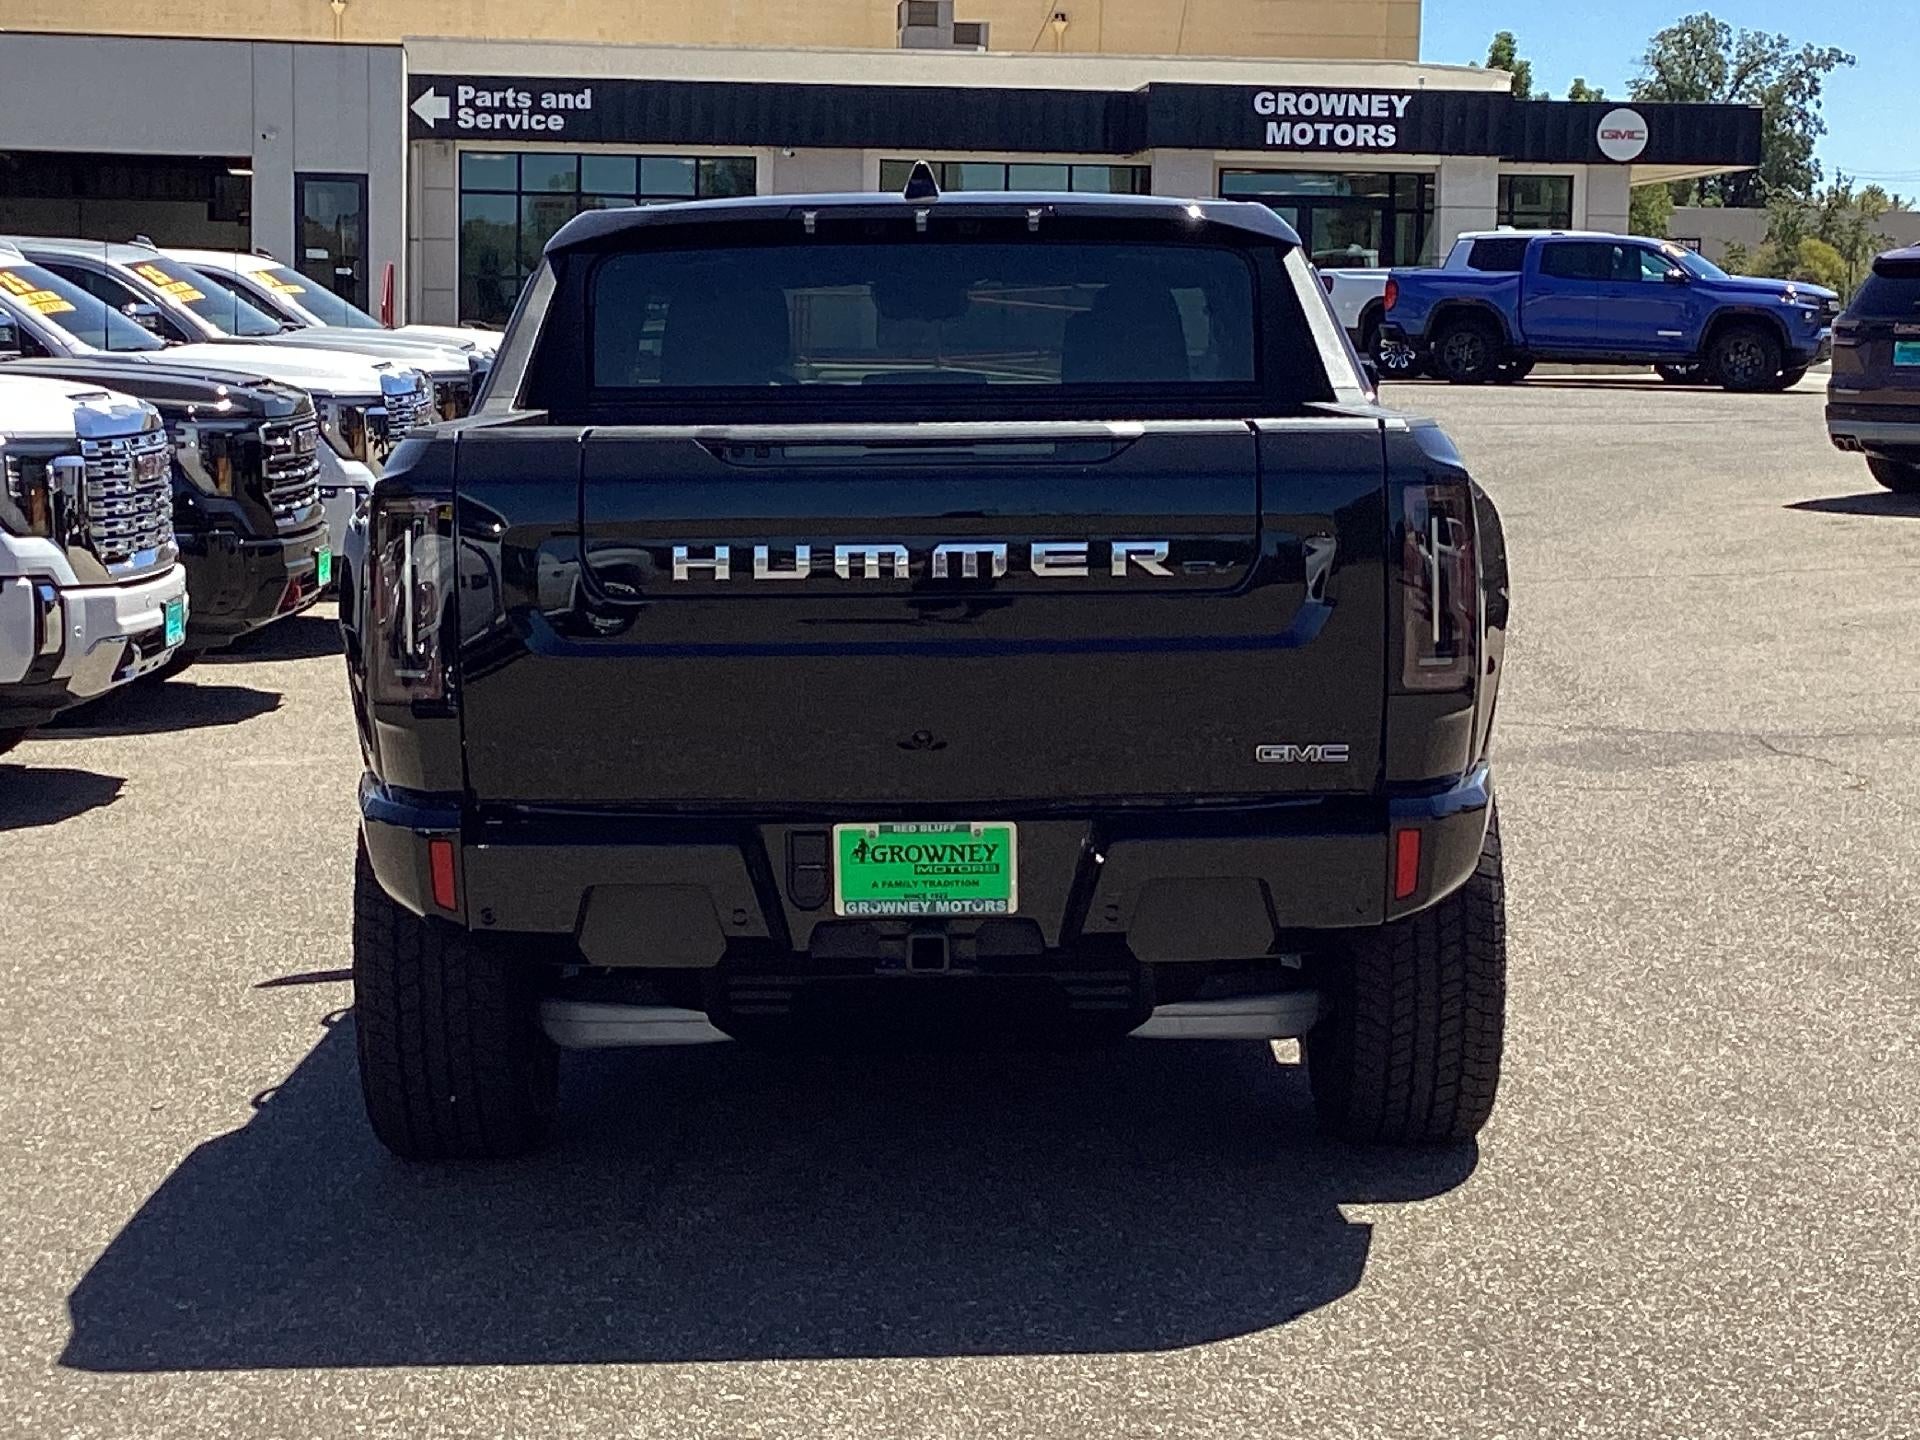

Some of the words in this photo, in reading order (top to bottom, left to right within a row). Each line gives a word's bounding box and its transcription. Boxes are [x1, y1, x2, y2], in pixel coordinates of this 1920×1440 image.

[457, 85, 532, 108] Parts
[541, 89, 592, 109] and
[1254, 91, 1412, 118] GROWNEY
[457, 107, 565, 131] Service
[1265, 121, 1397, 148] MOTORS
[1601, 130, 1646, 140] GMC
[672, 541, 1174, 580] HUMMER
[1256, 744, 1349, 762] GMC
[893, 824, 917, 833] RED
[920, 824, 957, 833] BLUFF
[870, 844, 999, 863] GROWNEY
[916, 865, 997, 873] MOTORS
[871, 880, 879, 888] A
[881, 880, 918, 888] FAMILY
[922, 880, 980, 888] TRADITION
[845, 901, 932, 913] GROWNEY
[936, 900, 1007, 913] MOTORS
